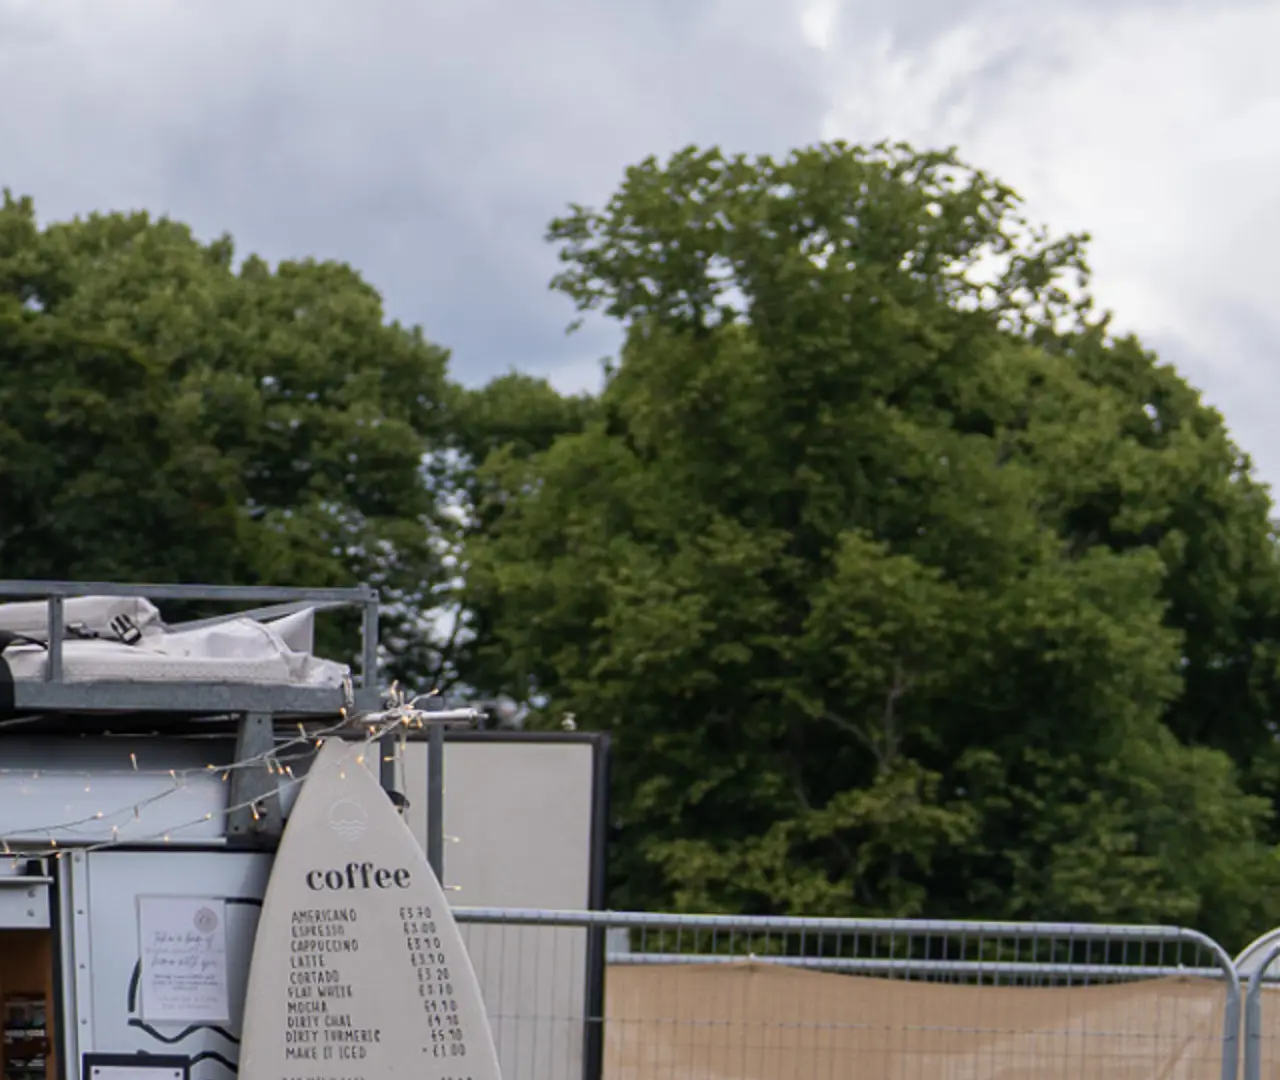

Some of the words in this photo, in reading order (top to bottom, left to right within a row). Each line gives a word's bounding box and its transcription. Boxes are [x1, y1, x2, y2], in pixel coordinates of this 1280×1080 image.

[306, 862, 411, 891] coffee
[292, 909, 357, 923] AMERICANO
[292, 924, 344, 938] ESPRESSO
[291, 939, 359, 952] CAPPUCCINO
[291, 955, 325, 968] LATTE
[290, 971, 339, 983] CORTADO
[288, 986, 312, 998] FLAT
[318, 986, 352, 998] WHITE
[288, 1001, 328, 1013] MOCHA
[288, 1015, 319, 1028] DIRTY
[326, 1015, 352, 1028] CHAI
[286, 1031, 318, 1043] DIRTY
[325, 1029, 381, 1042] TURMERIC
[286, 1047, 316, 1060] MAKE
[324, 1047, 333, 1059] IT
[339, 1046, 366, 1059] ICED
